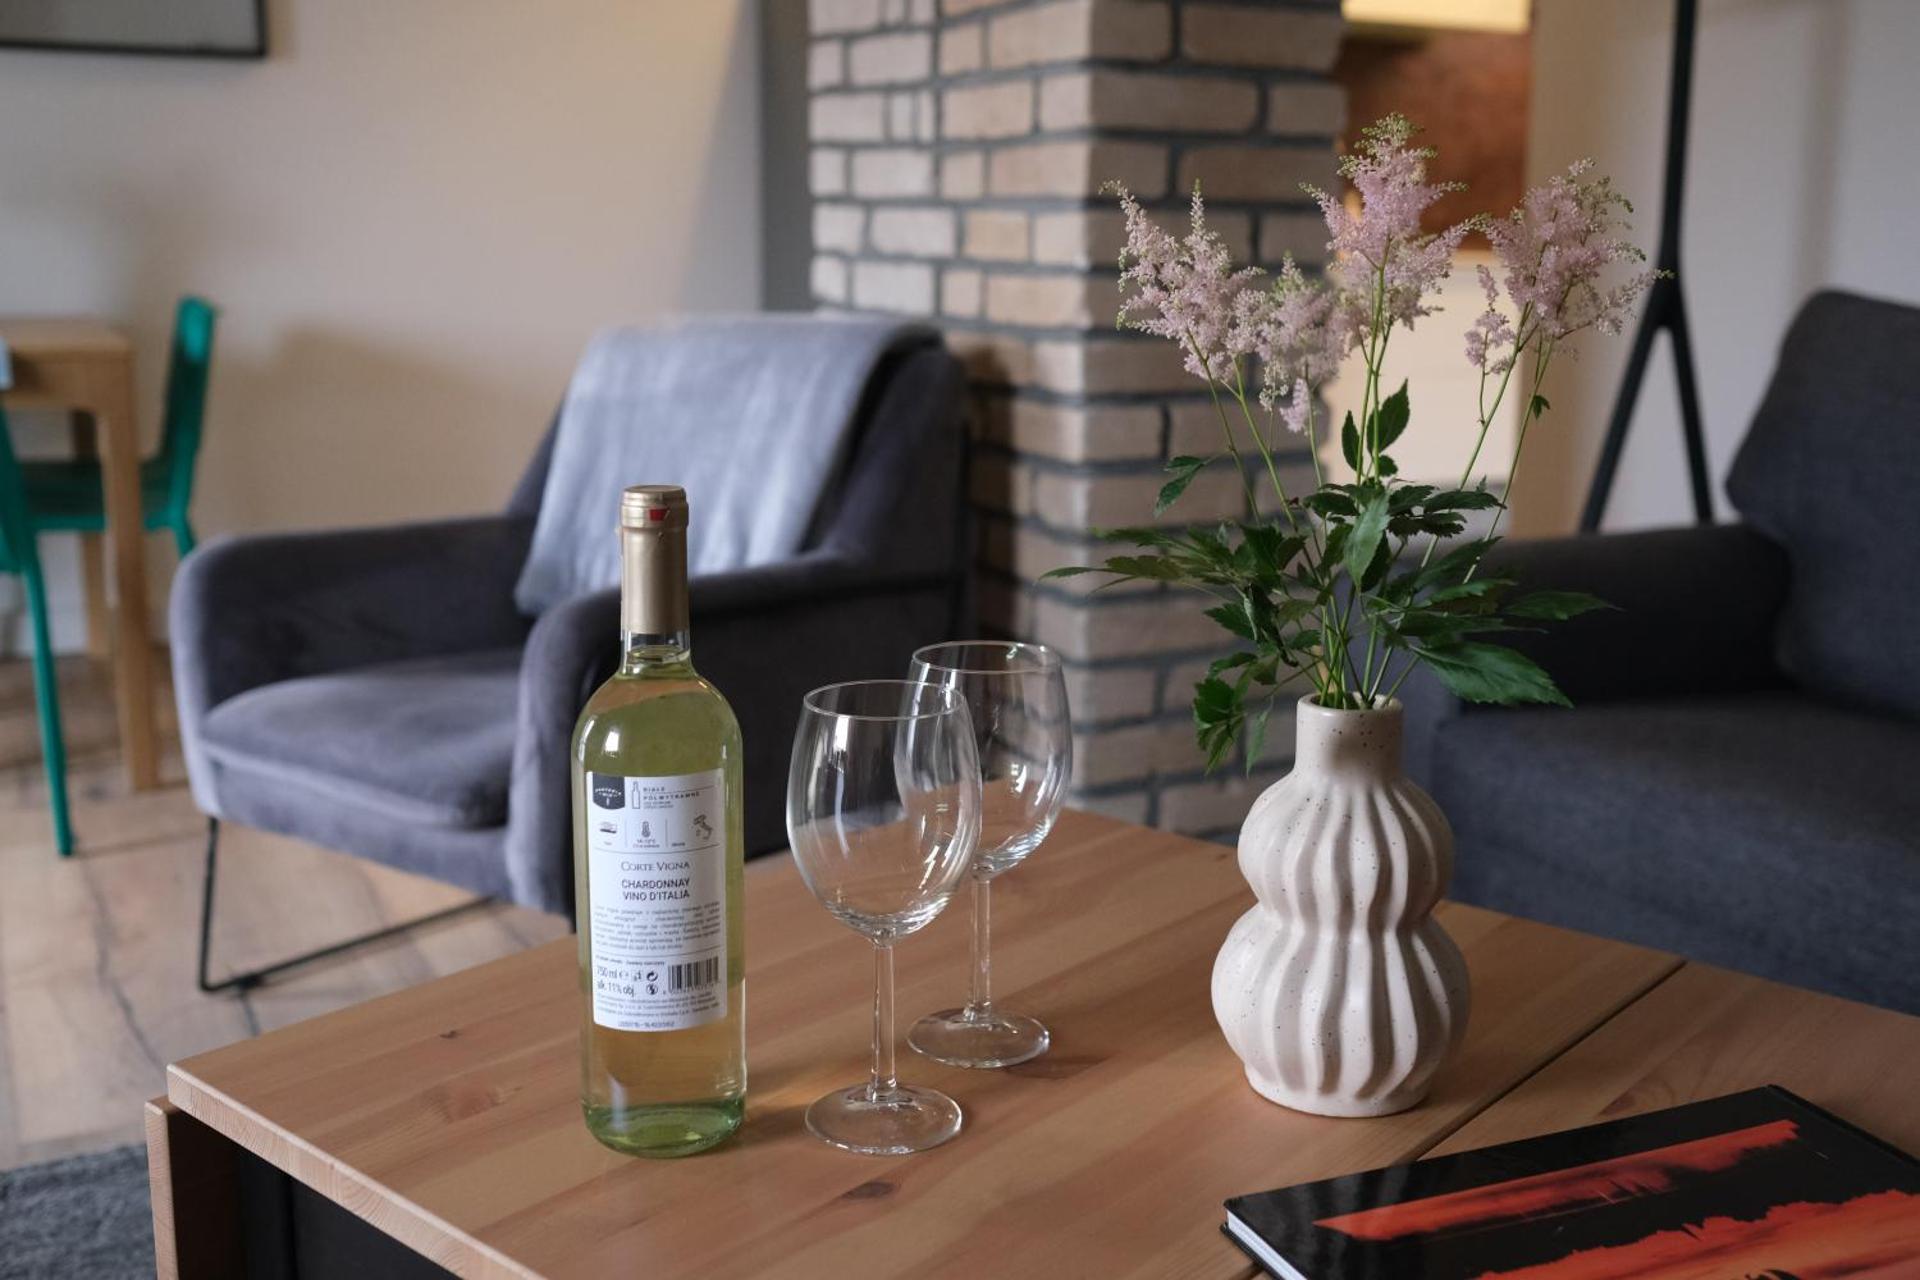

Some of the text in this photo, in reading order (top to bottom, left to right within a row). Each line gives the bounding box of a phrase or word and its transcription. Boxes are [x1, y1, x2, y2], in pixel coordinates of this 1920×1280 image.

[621, 861, 690, 872] CORTE VIGNA
[621, 878, 690, 889] CHARDONNAY
[623, 889, 690, 901] VINO D'ITALIA
